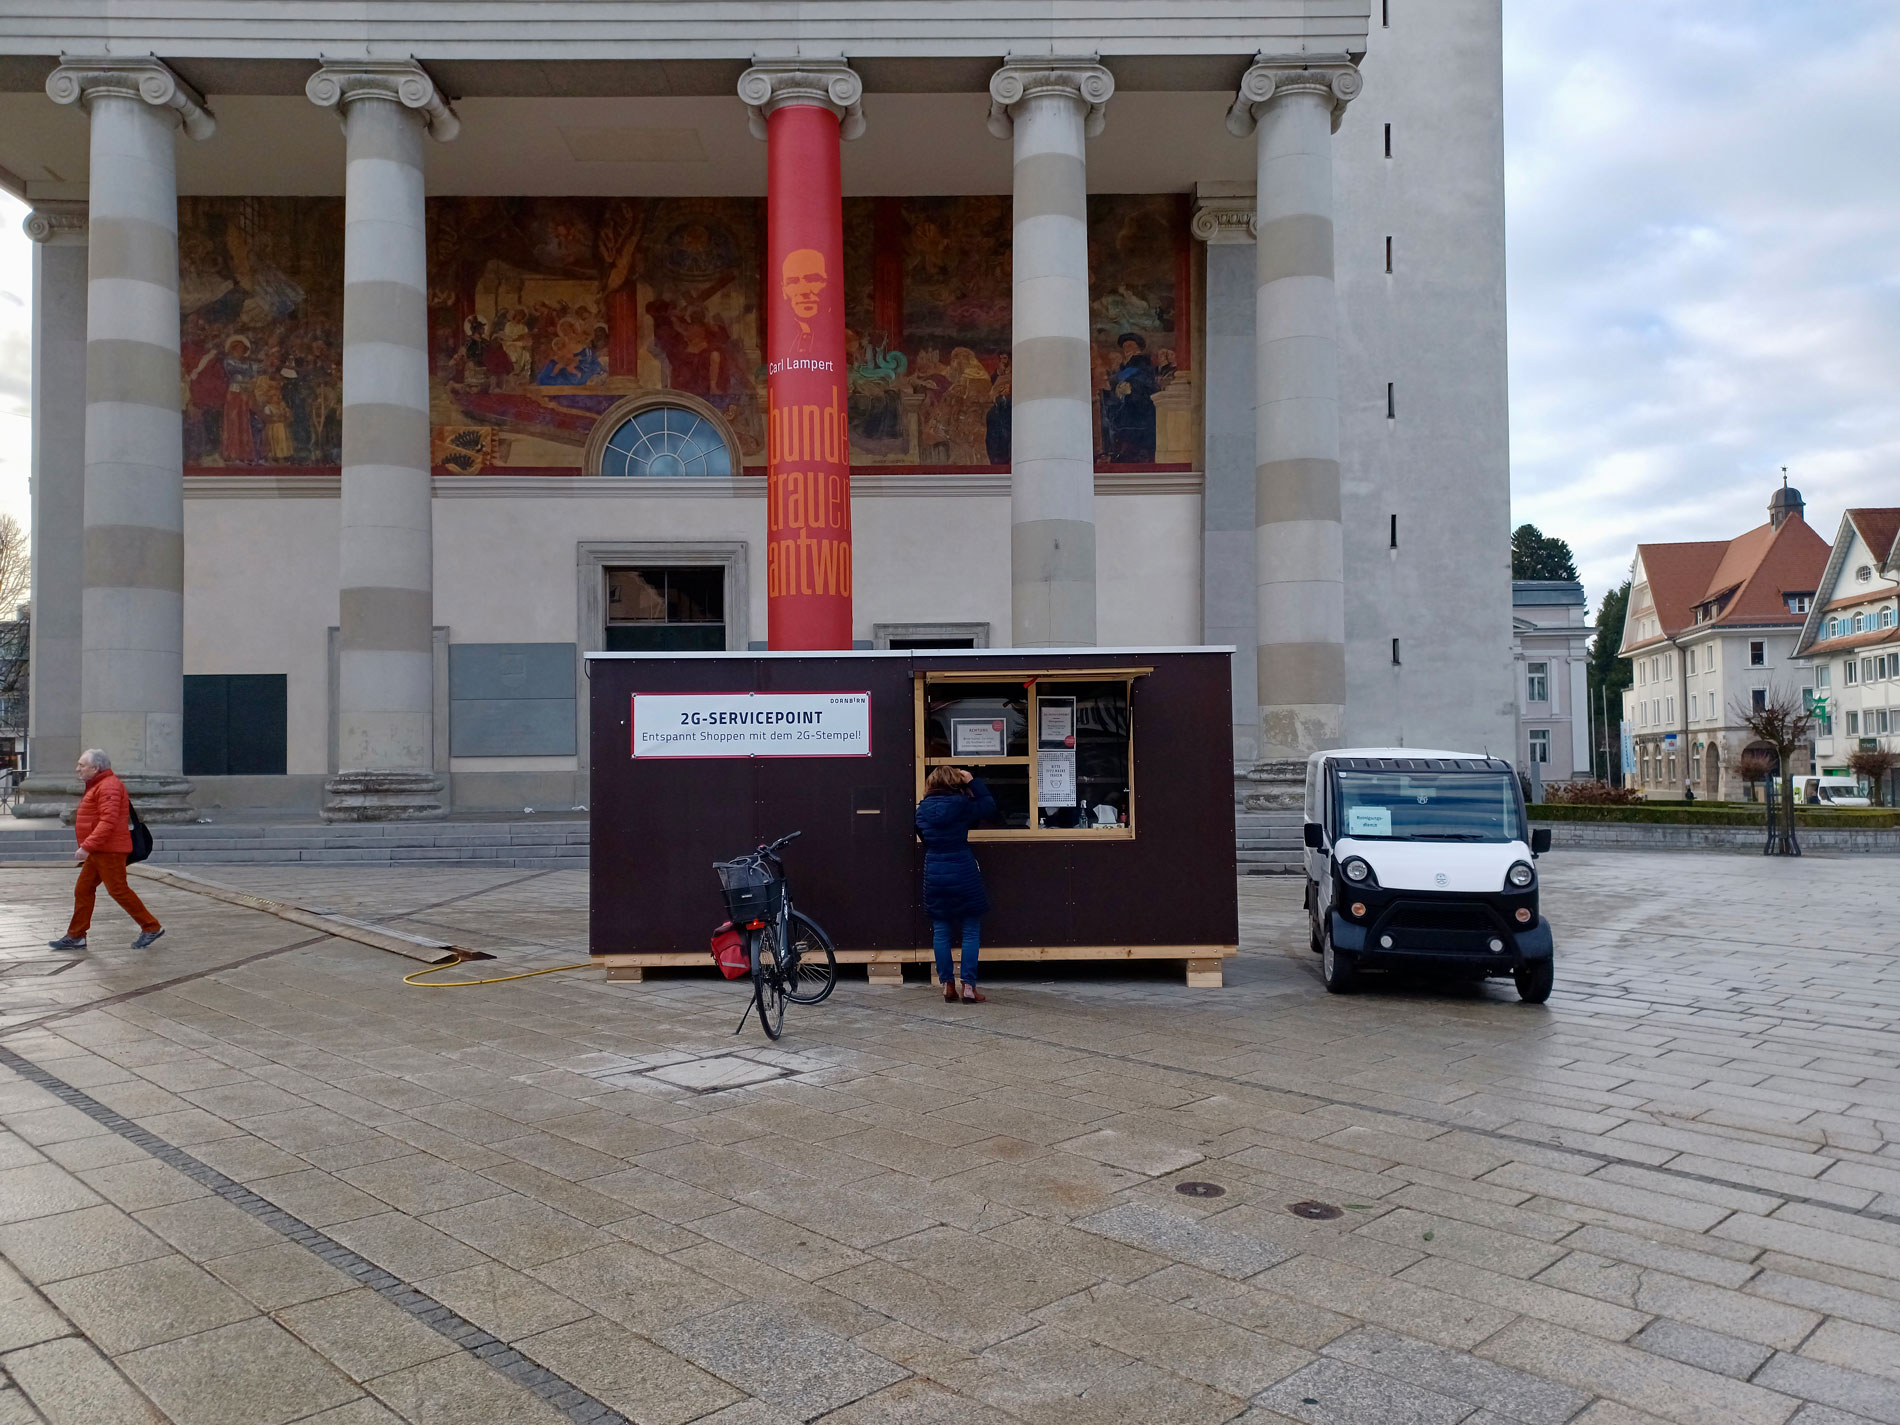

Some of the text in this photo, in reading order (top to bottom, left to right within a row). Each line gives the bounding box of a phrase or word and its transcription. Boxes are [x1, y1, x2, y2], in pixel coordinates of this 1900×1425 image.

[769, 357, 834, 375] Carl Lampert
[680, 711, 823, 725] 2G-SERVICEPOINT
[642, 730, 862, 743] Entspannt Shoppen mit dem 2G-Stempel!
